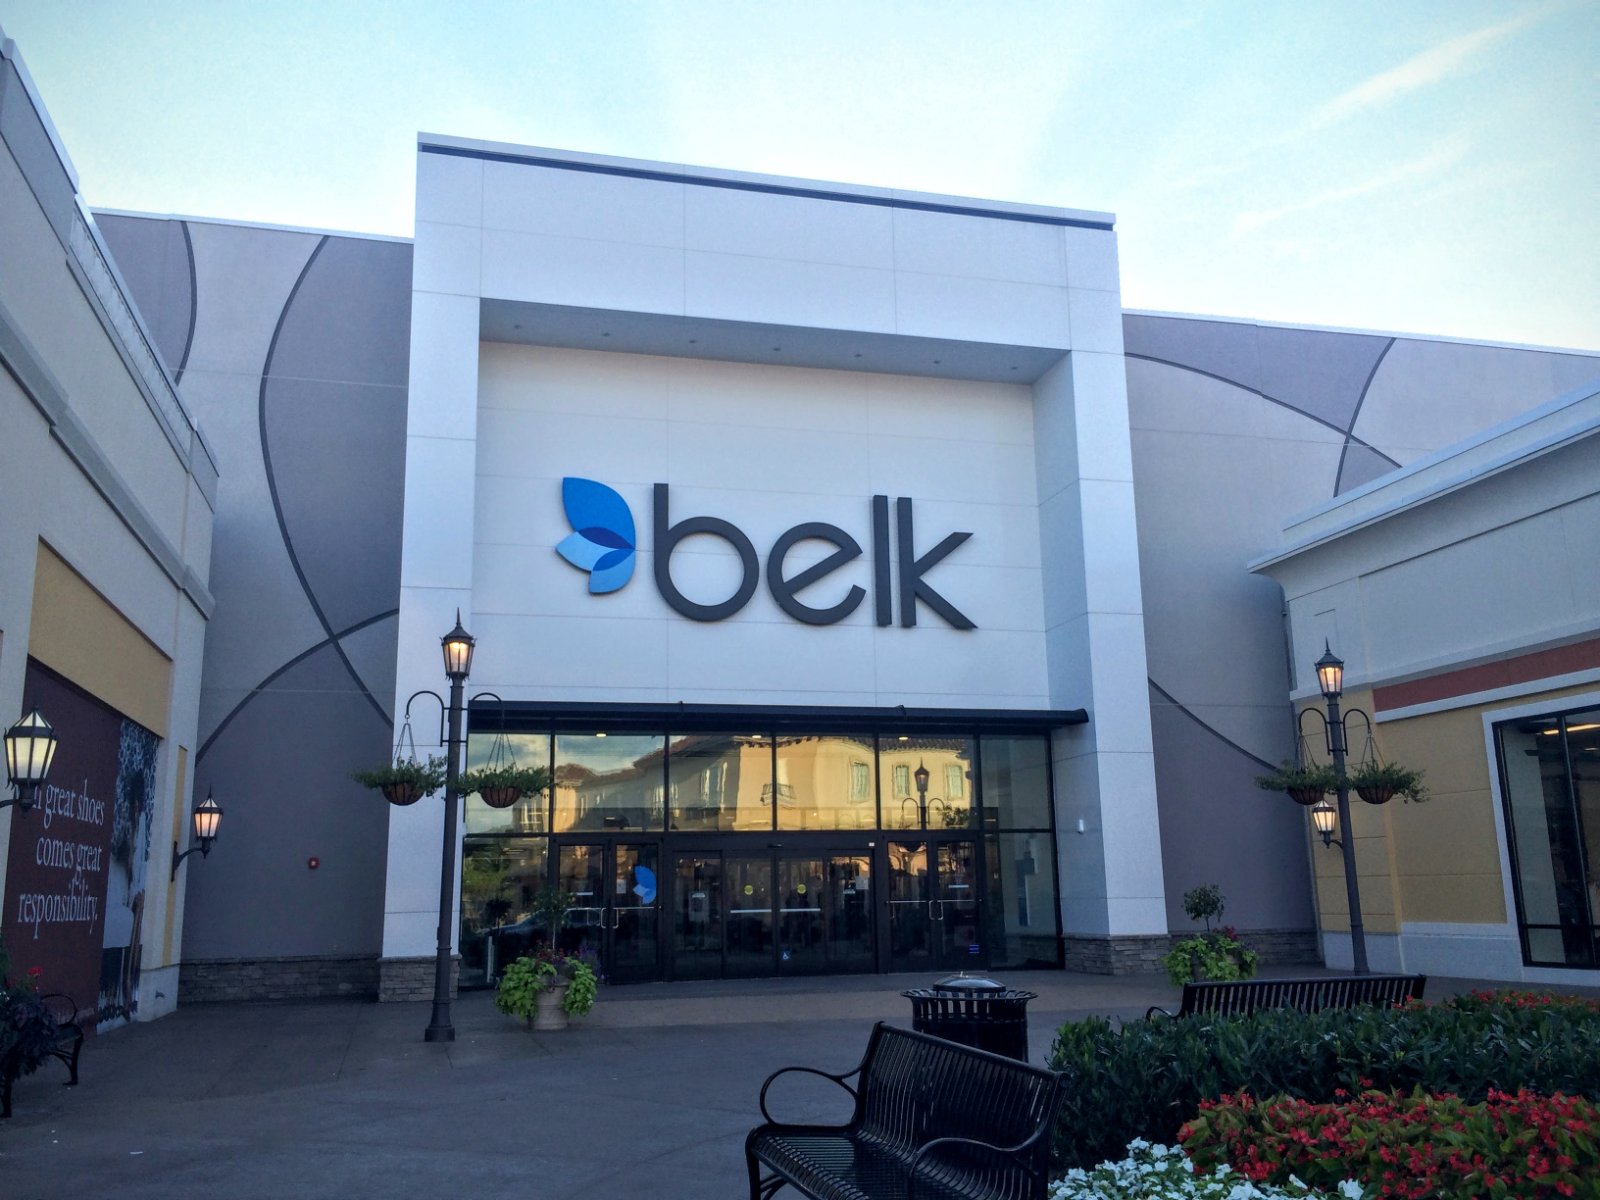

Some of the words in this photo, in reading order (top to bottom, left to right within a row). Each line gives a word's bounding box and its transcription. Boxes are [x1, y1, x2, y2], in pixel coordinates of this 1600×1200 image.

[653, 483, 979, 630] belk
[44, 784, 76, 829] great
[77, 779, 105, 827] shoes
[36, 837, 75, 869] comes
[75, 843, 102, 885] great
[17, 878, 98, 939] responsibility.
